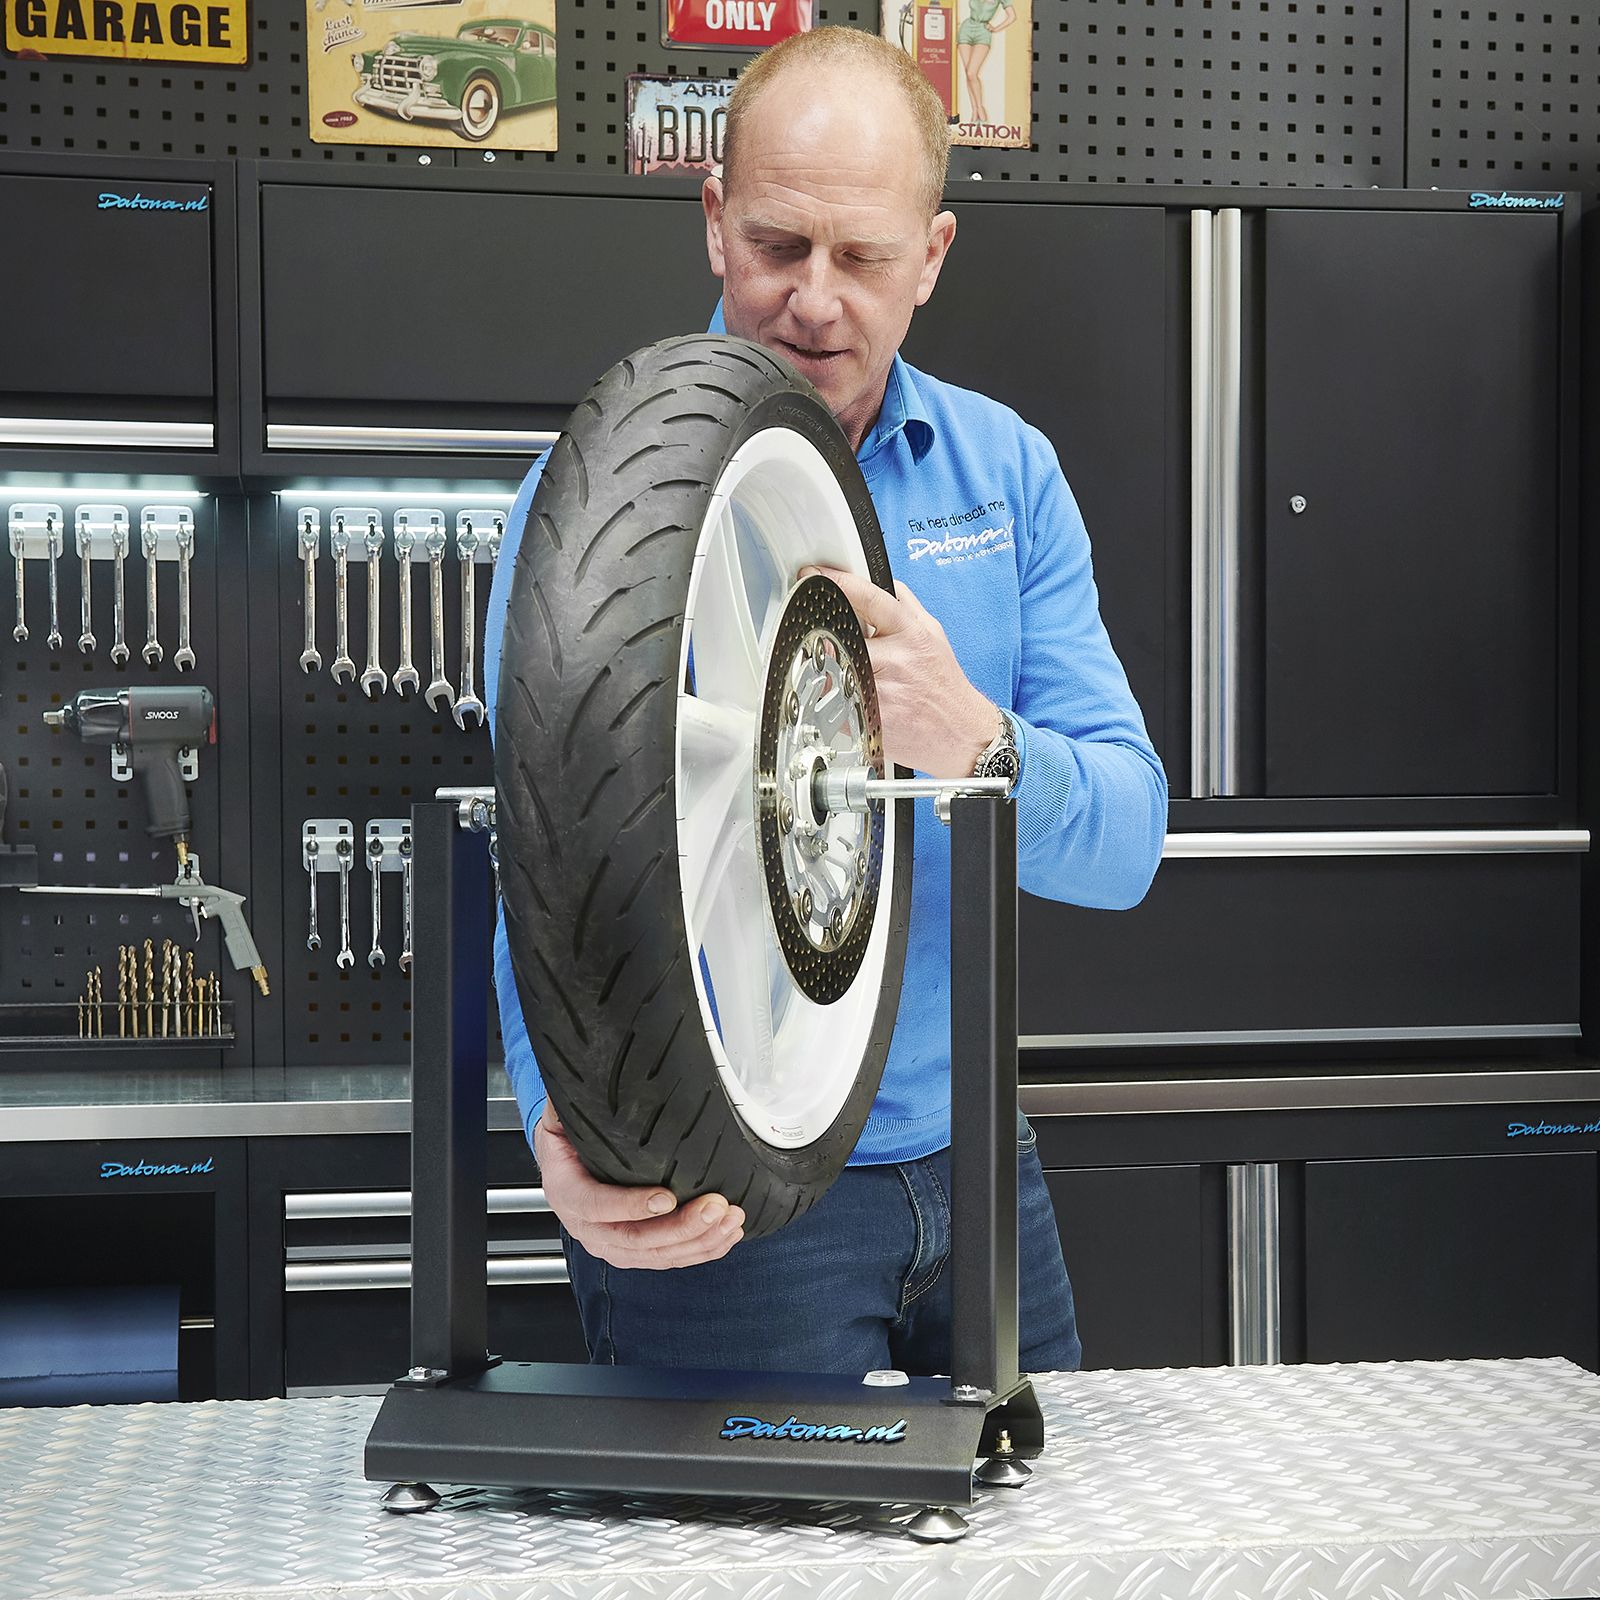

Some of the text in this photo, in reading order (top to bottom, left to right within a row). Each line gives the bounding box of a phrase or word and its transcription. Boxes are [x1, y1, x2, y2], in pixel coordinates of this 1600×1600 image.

[14, 0, 232, 48] GARAGE
[324, 15, 352, 31] Last
[705, 0, 777, 31] ONLY
[323, 27, 361, 47] chance
[958, 123, 1021, 140] STATION
[97, 192, 209, 211] Datona.nl
[1469, 191, 1565, 208] Datona.nl
[908, 519, 926, 533] Fix
[926, 517, 949, 529] het
[948, 504, 987, 527] direct
[99, 1155, 215, 1179] Datona.nl
[721, 1416, 907, 1441] Datona.nl
